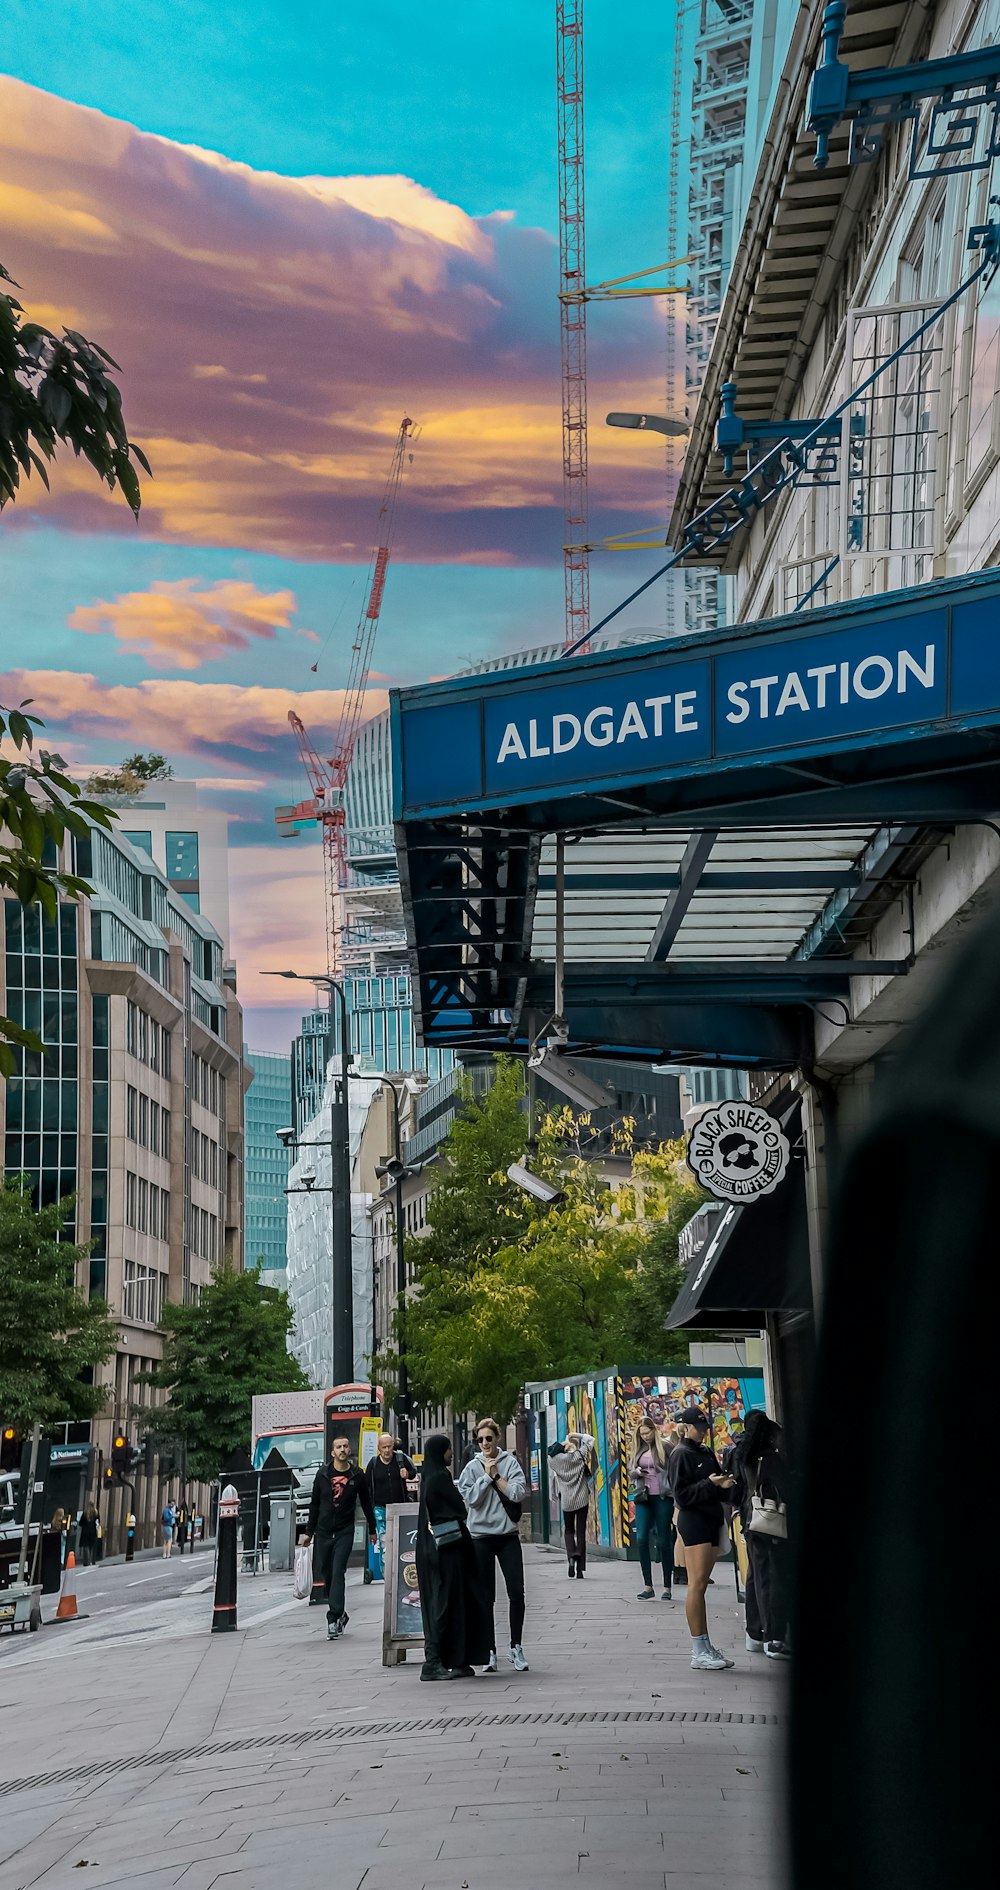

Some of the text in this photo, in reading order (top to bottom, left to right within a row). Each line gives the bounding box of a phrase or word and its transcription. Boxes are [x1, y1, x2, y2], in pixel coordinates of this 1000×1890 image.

[497, 644, 935, 763] ALDGATE STATION
[696, 1109, 772, 1156] BLACK SHEEP
[712, 1152, 779, 1194] SPECIAL COFFEE BEANS
